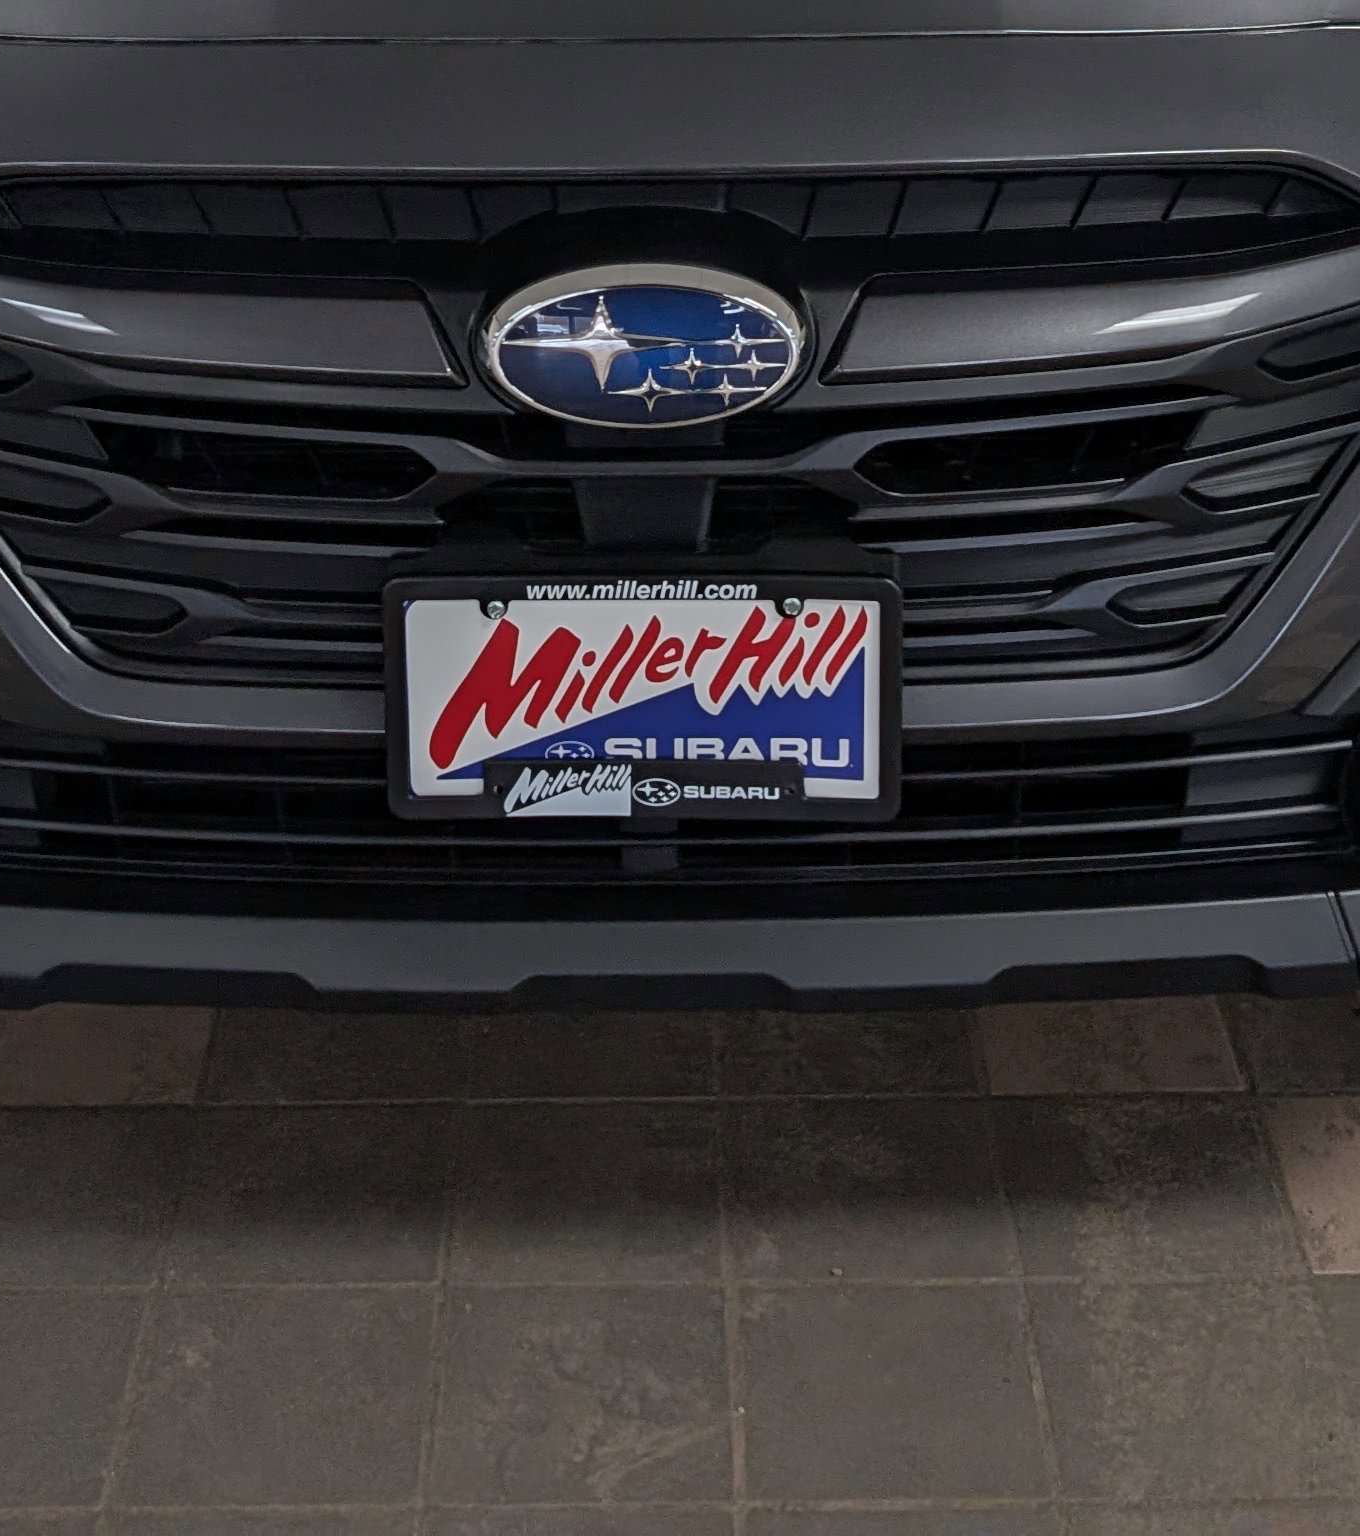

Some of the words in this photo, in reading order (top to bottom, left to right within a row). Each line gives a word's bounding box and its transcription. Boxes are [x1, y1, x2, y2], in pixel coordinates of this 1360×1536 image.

[526, 579, 758, 600] www.millerhill.com
[604, 737, 850, 768] SUBARU
[683, 785, 780, 800] SUBARU
